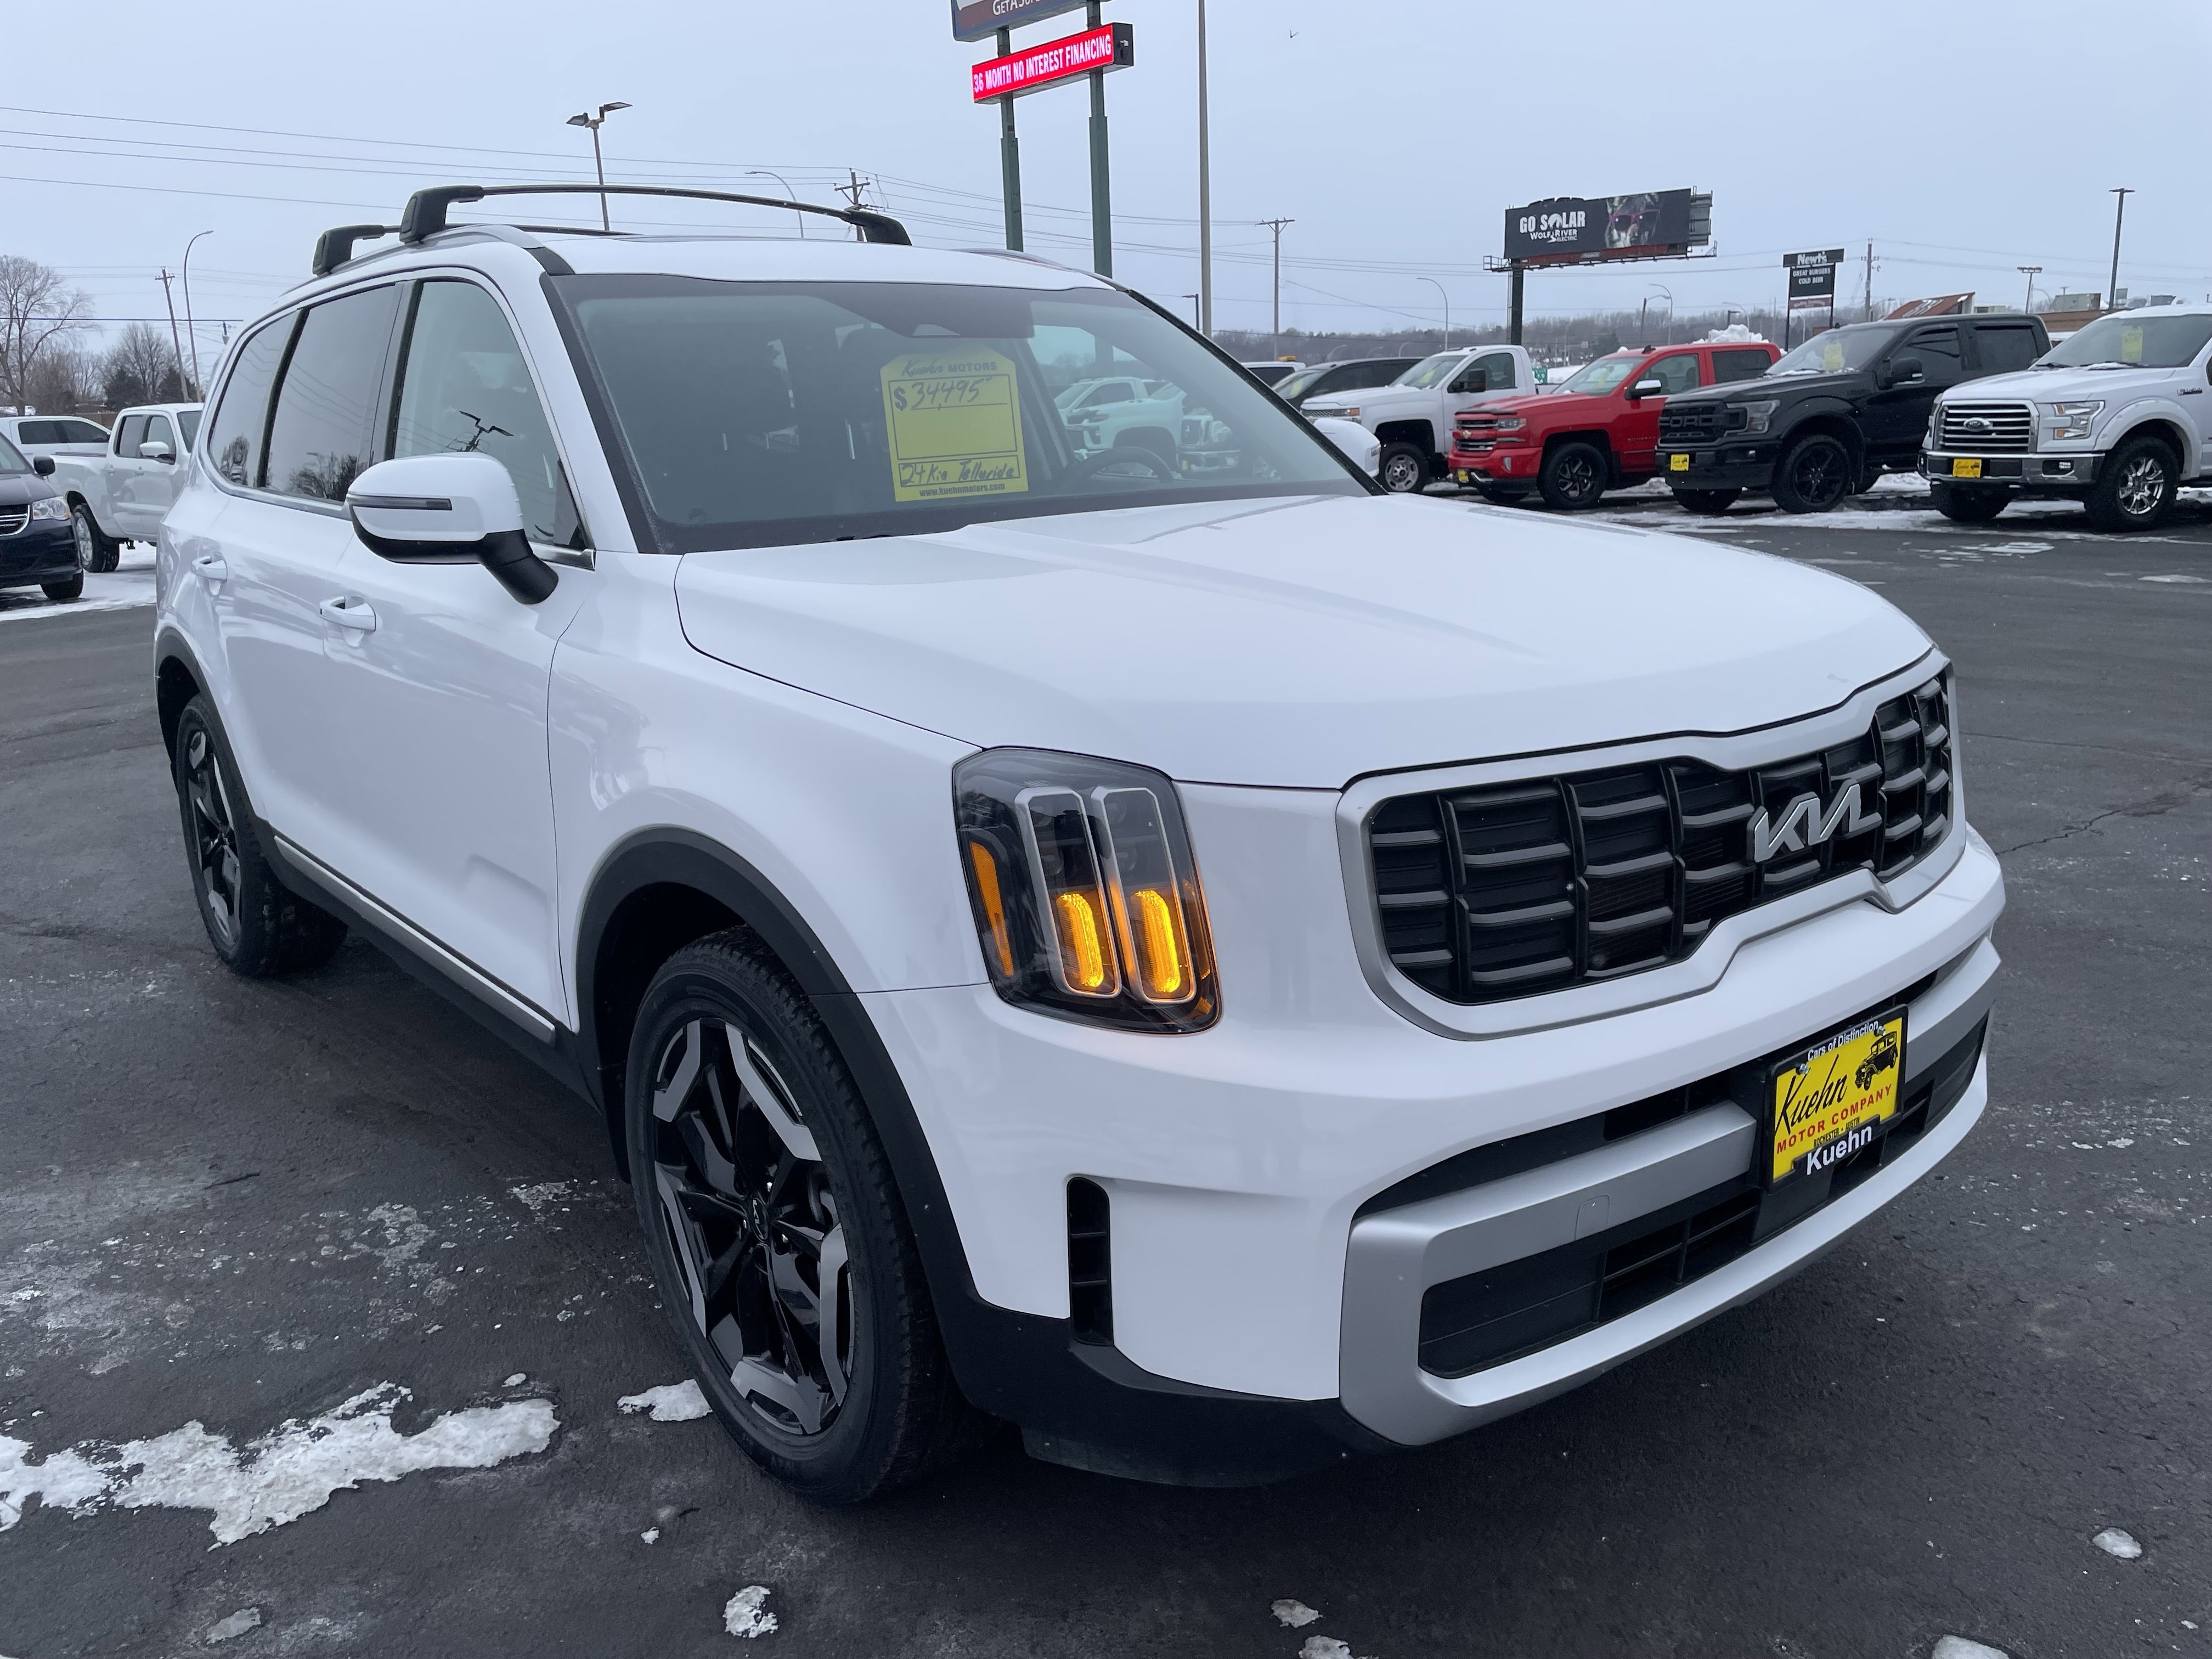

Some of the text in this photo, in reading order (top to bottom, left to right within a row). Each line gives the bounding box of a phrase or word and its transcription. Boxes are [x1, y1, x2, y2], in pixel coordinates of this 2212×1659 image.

[973, 33, 1111, 93] 36 MONTH NO INTEREST FINANCING
[1520, 211, 1585, 233] GO SOLAR
[1530, 229, 1577, 240] WOLF RIVER
[1797, 251, 1827, 265] Newt's
[948, 362, 997, 373] MOTORS
[919, 483, 1006, 496] www.kuehnmotors.com
[1807, 1020, 1878, 1061] Cars of Distinction
[1774, 1054, 1848, 1137] Kuehn
[1776, 1084, 1892, 1154] MOTOR COMPANY
[1813, 1127, 1839, 1148] ROCHESTER
[1807, 1125, 1872, 1175] Kuehn
